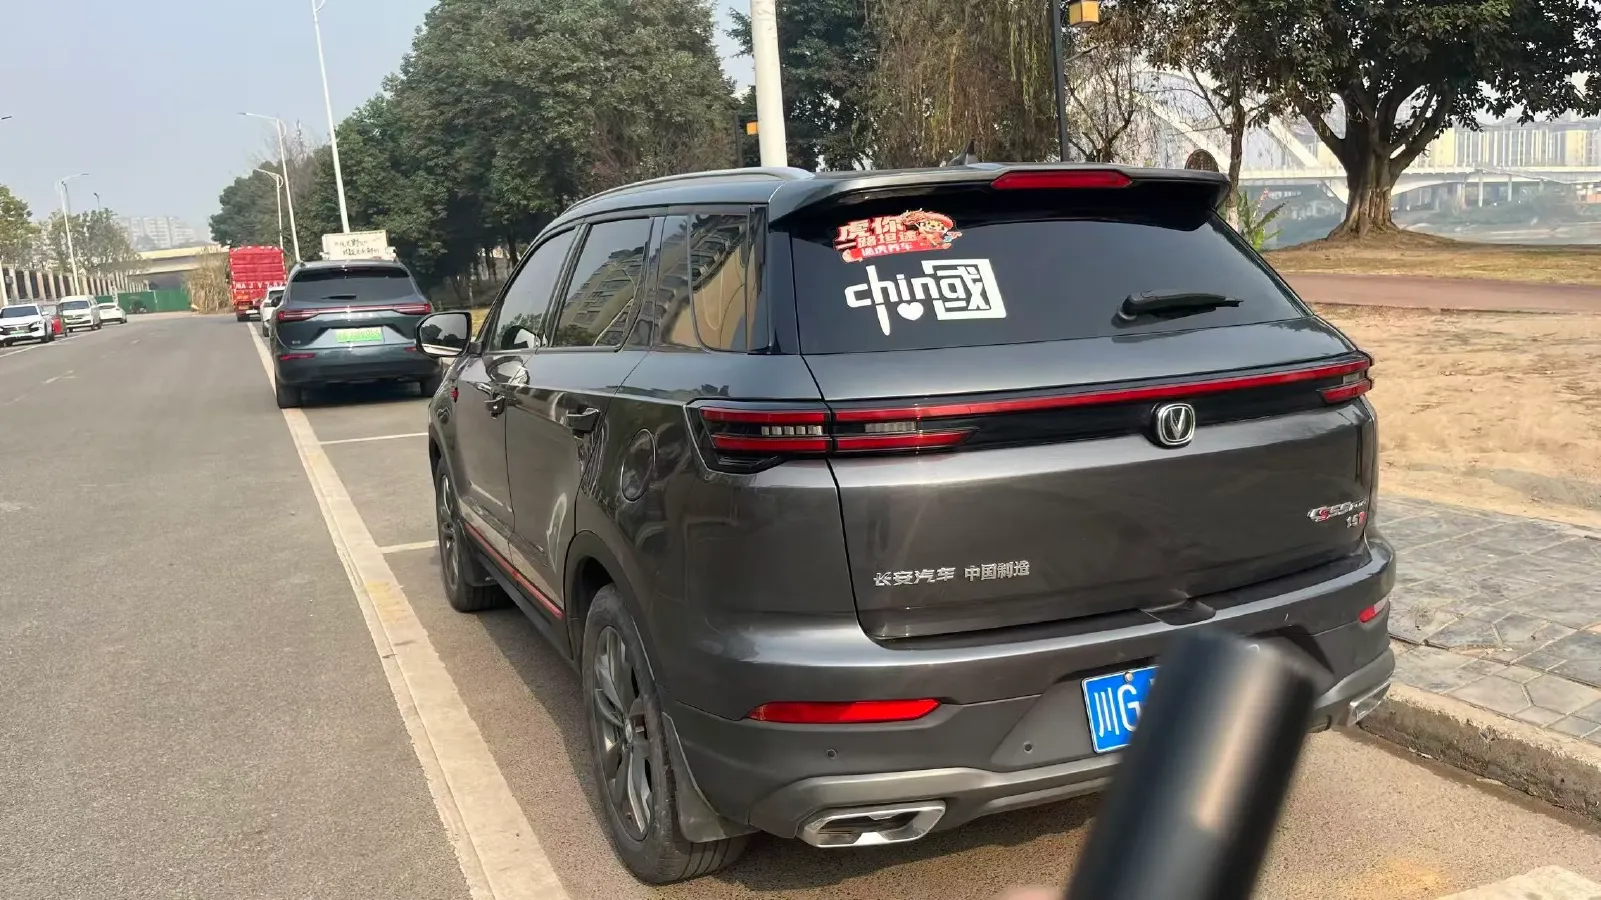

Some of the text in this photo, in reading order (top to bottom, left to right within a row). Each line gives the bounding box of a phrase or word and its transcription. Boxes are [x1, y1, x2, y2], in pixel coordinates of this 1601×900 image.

[873, 560, 1030, 587] 长安汽车 中国制造
[1093, 678, 1156, 738] 川G
